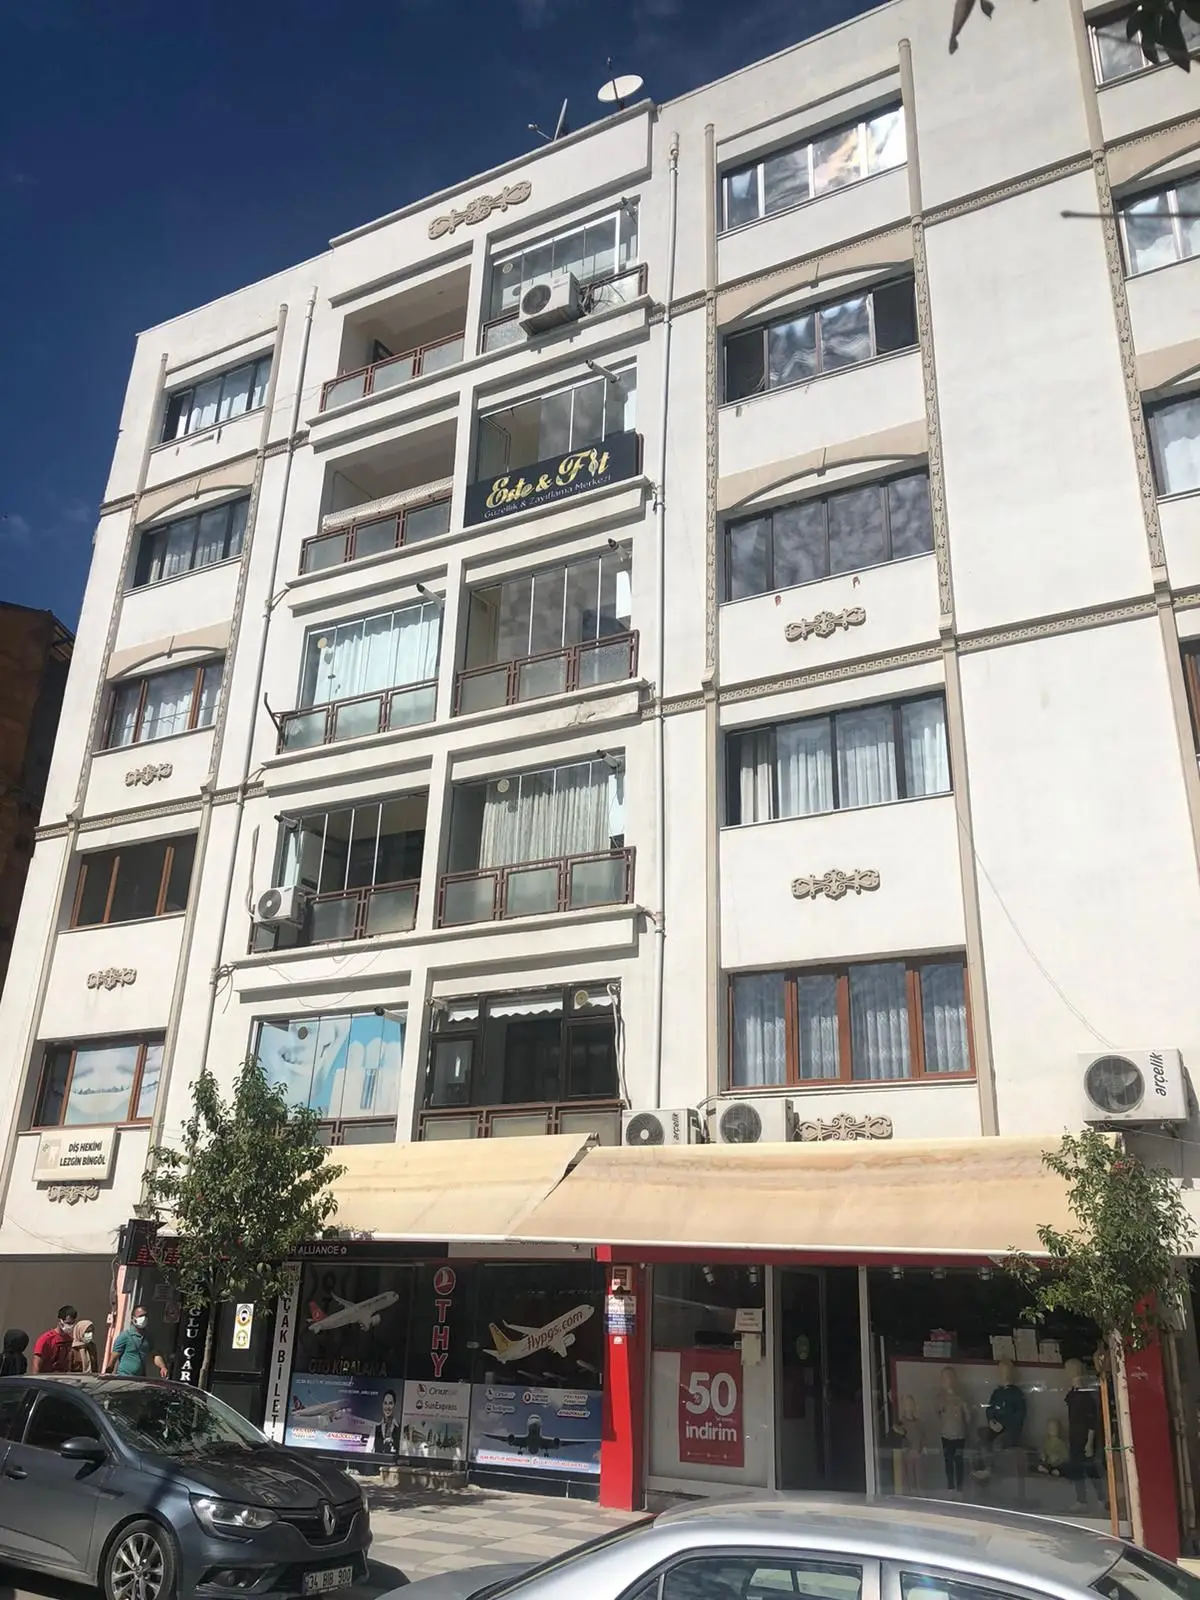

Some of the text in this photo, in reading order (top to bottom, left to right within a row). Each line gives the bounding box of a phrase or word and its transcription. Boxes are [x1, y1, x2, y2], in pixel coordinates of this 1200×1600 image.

[485, 475, 535, 509] Este
[535, 473, 553, 492] &
[574, 474, 611, 492] Merkezi
[1149, 1051, 1168, 1097] arçelik
[671, 1112, 681, 1141] arçelik
[60, 1154, 106, 1167] LEZGİN BİNGÖL
[68, 1140, 103, 1153] DİŞ HEKİMİ
[297, 1244, 339, 1255] ALLIANCE
[279, 1289, 292, 1343] ÇAK
[527, 1310, 583, 1351] flypgs.com
[430, 1299, 452, 1378] THY
[179, 1347, 196, 1385] ÇAR
[424, 1400, 458, 1411] SunExpress
[685, 1371, 737, 1416] 50
[685, 1420, 737, 1442] indirim
